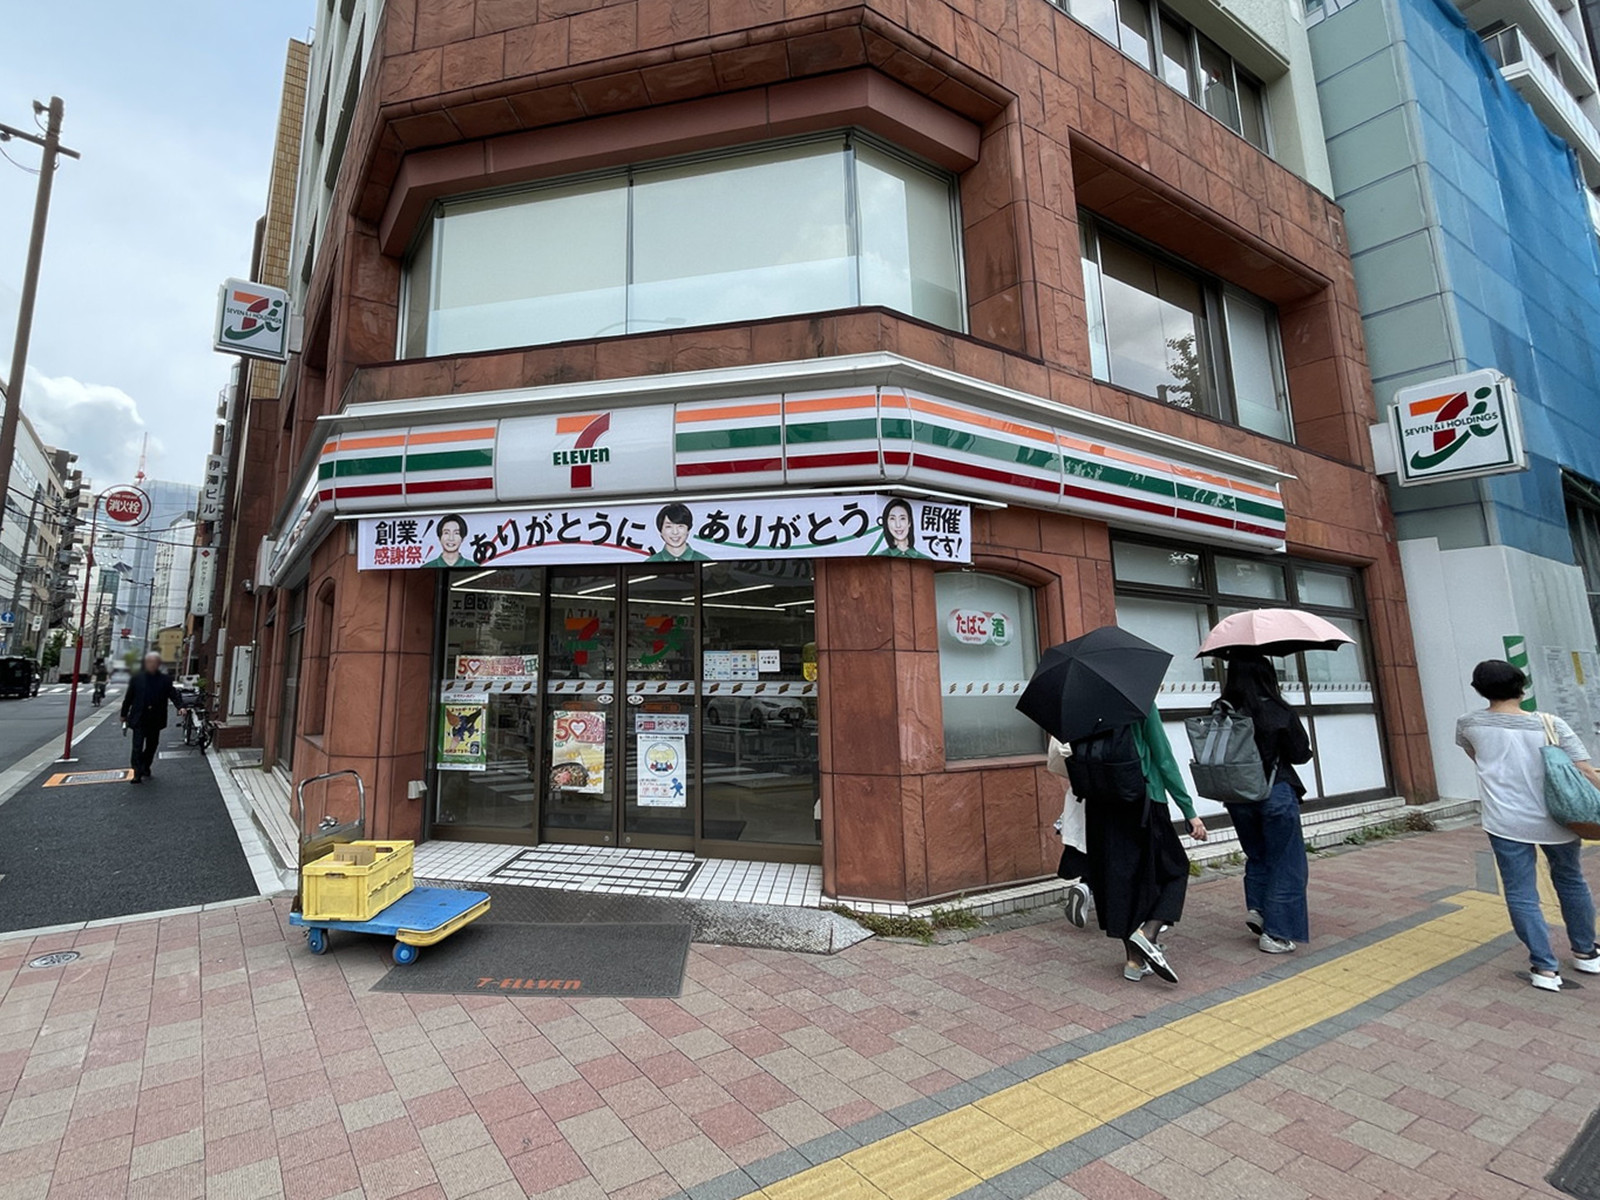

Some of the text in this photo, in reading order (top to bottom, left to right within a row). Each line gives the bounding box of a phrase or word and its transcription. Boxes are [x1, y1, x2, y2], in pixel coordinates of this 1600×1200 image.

[253, 313, 282, 324] HOLDINGS
[1447, 411, 1498, 429] HOLDINGS
[108, 499, 141, 515] 消火栓
[921, 505, 962, 534] 開催
[956, 613, 987, 635] たばこ
[991, 617, 1005, 637] 酒
